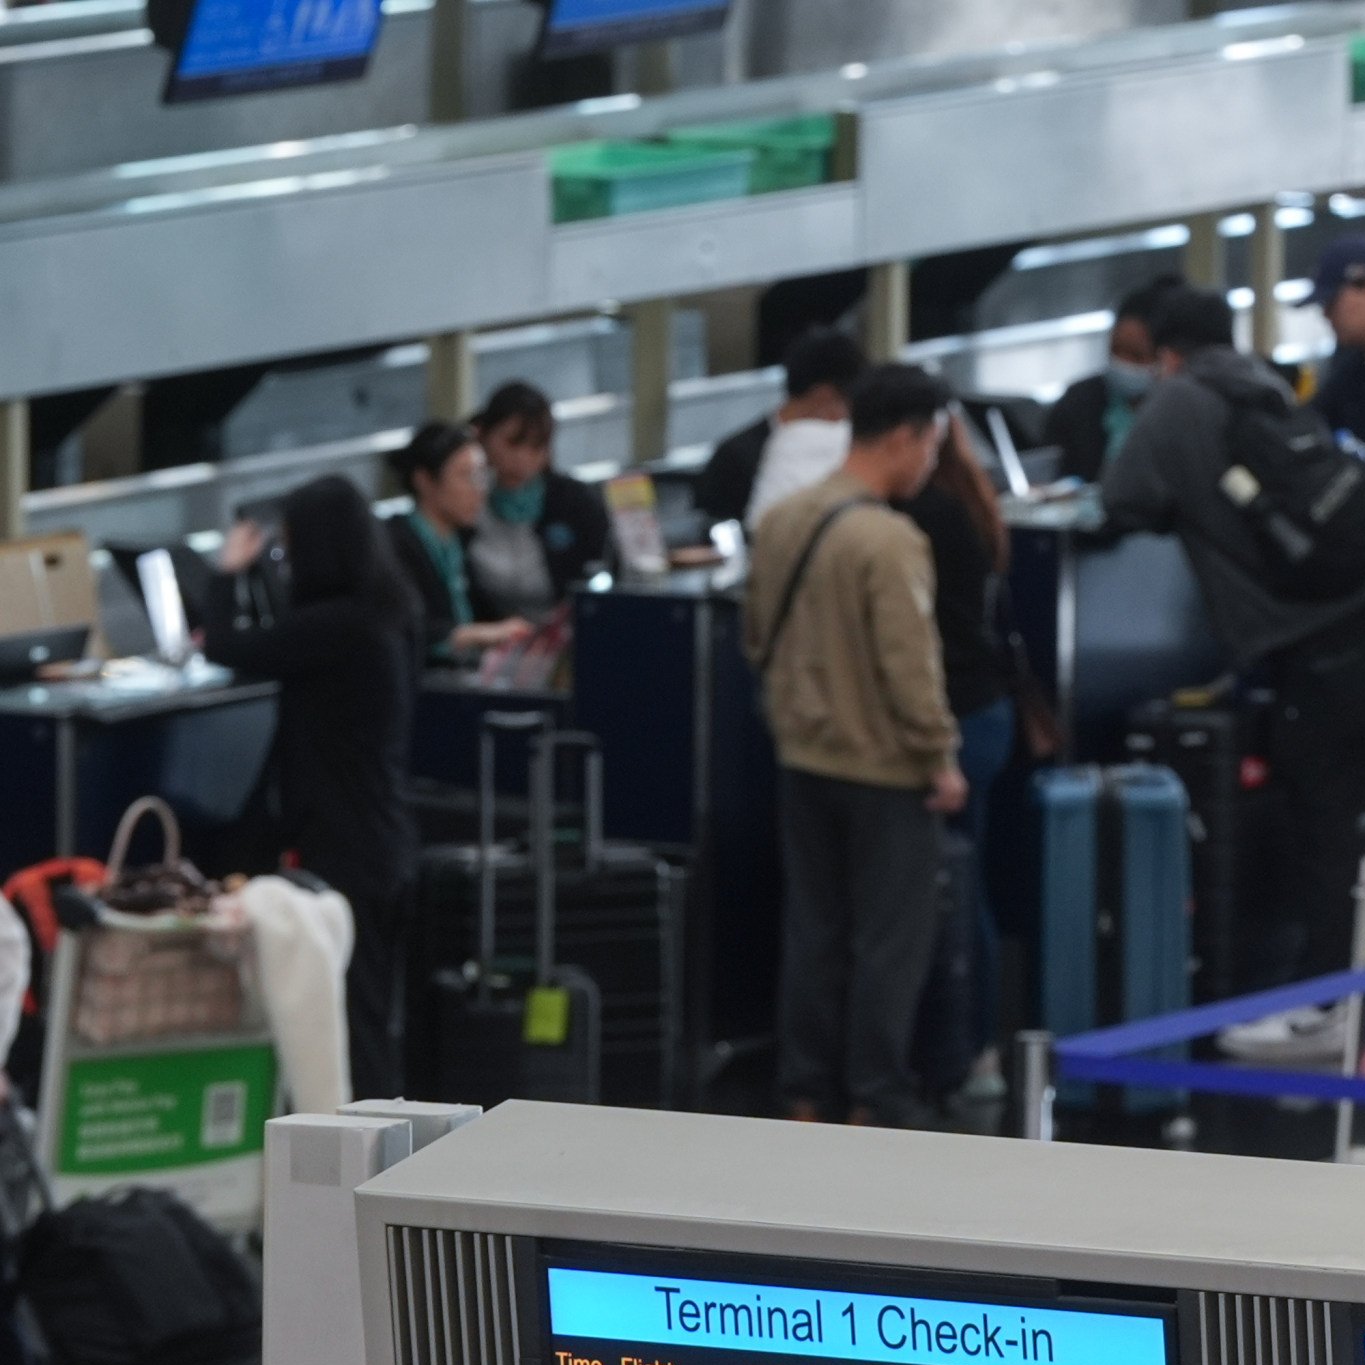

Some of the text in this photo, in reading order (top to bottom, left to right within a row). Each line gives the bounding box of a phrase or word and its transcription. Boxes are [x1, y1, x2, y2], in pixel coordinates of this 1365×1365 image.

[653, 1285, 1055, 1363] Terminal 1 Check-in
